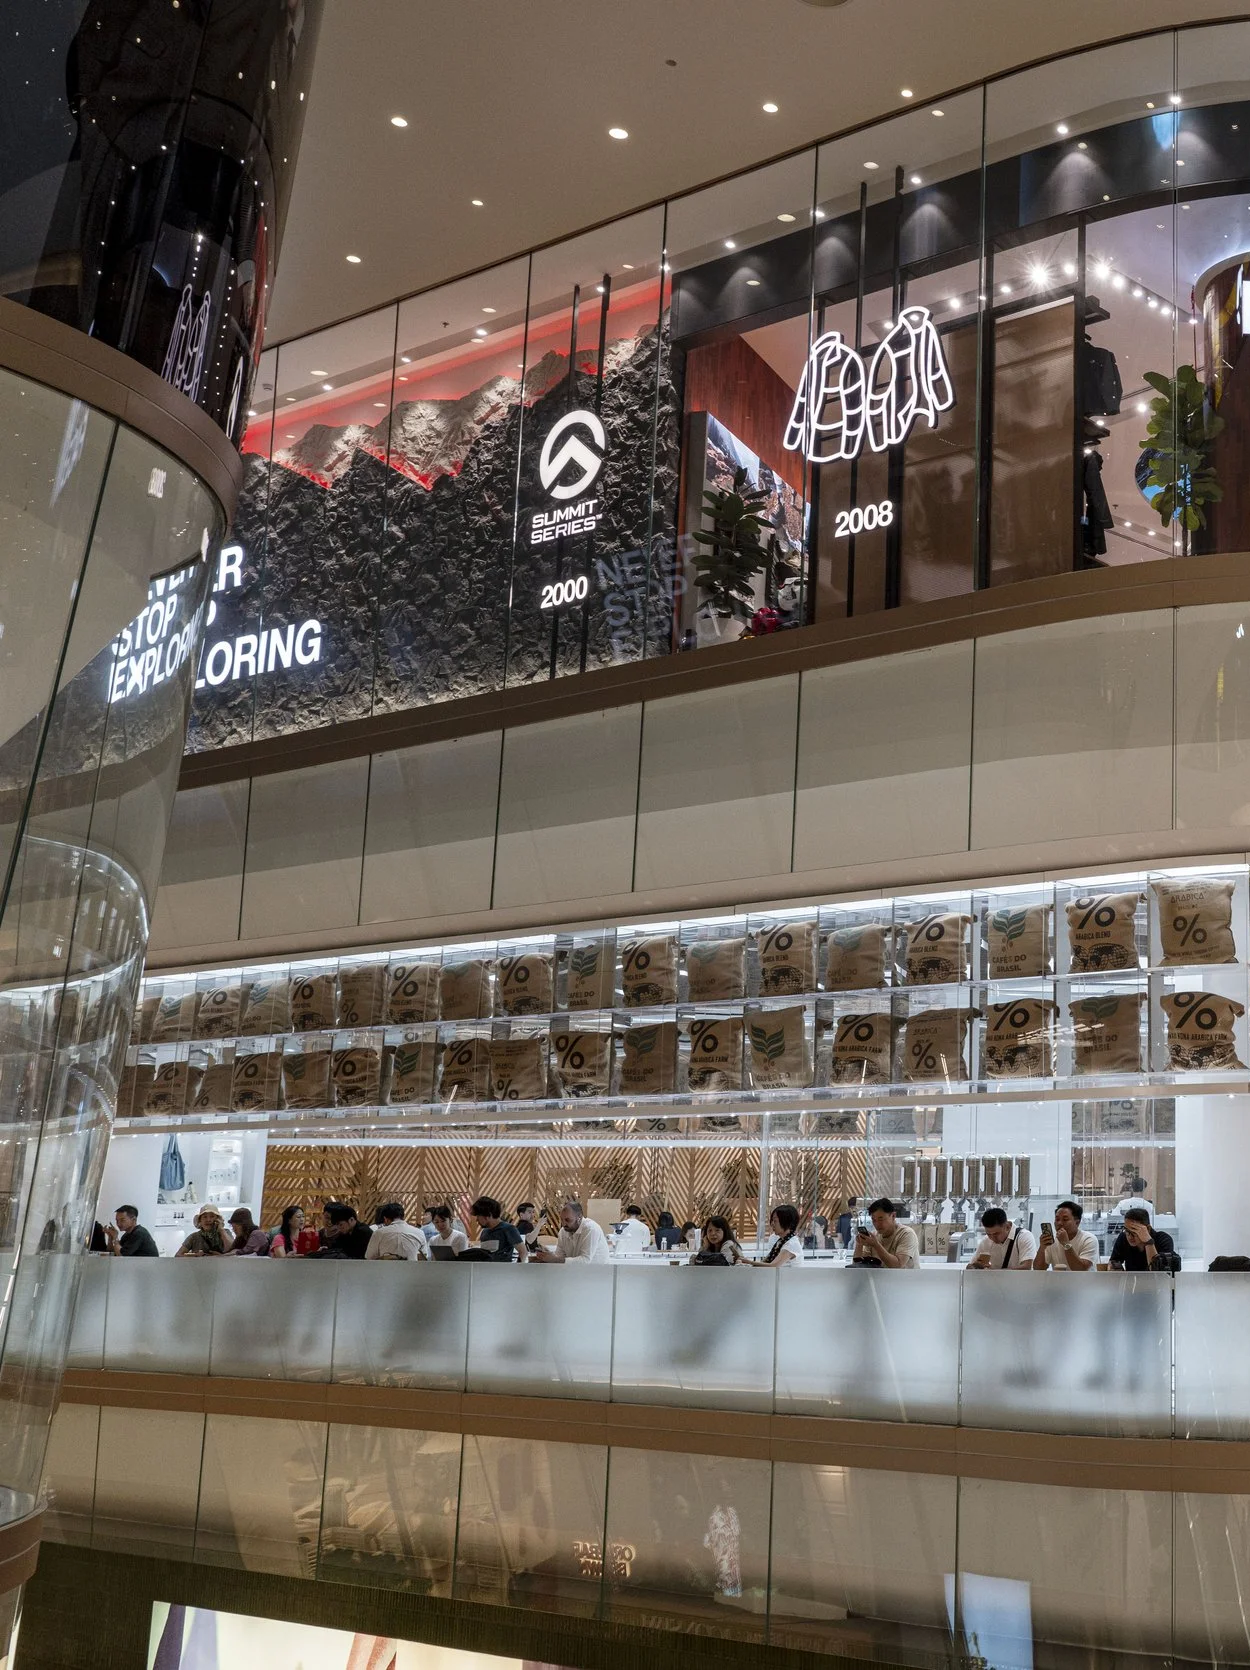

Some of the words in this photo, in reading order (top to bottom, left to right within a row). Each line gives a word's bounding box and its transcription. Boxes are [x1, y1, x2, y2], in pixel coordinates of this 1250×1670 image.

[532, 499, 598, 529] SUMMIT
[835, 500, 893, 538] 2008
[540, 576, 588, 609] 2000
[1075, 896, 1115, 929] %
[1171, 893, 1205, 903] ARABICA
[1173, 913, 1207, 946] %
[392, 966, 419, 997] %
[1174, 992, 1217, 1030] %
[556, 1035, 584, 1069] %
[1191, 1033, 1213, 1041] ARABICA
[912, 1043, 936, 1069] %
